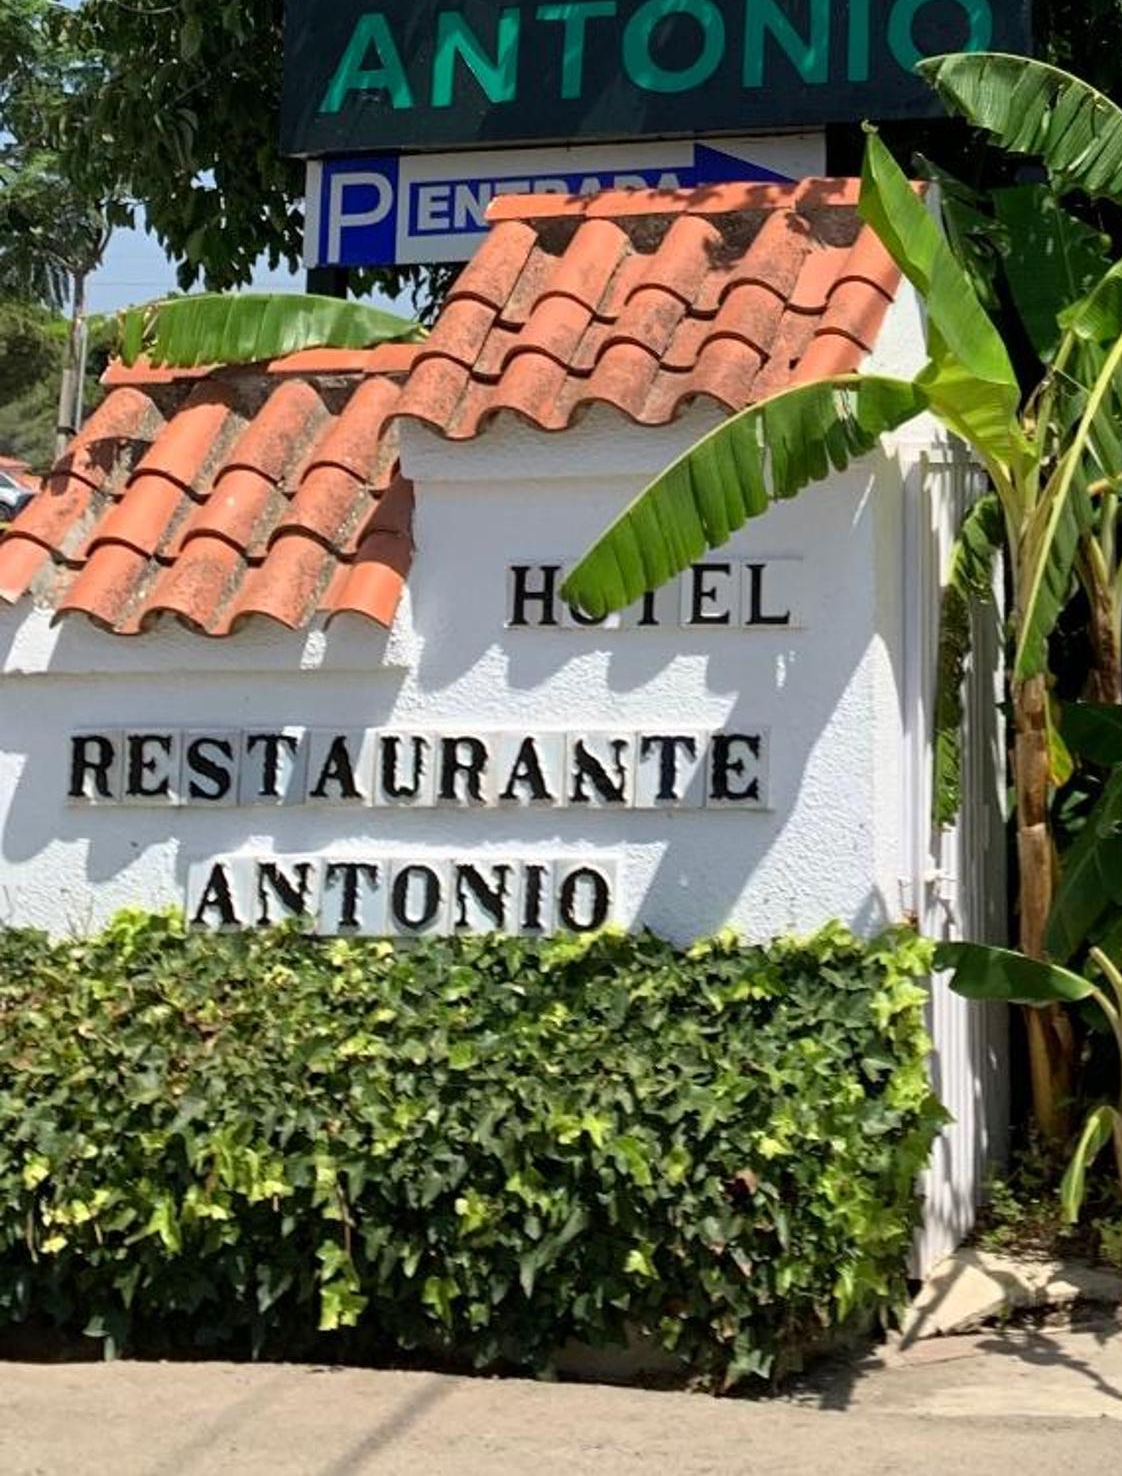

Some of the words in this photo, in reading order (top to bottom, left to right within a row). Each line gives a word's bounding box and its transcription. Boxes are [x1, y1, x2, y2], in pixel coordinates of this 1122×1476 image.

[329, 172, 393, 264] P
[68, 733, 762, 802] RESTAURANTE
[191, 862, 614, 931] ANTONIO
